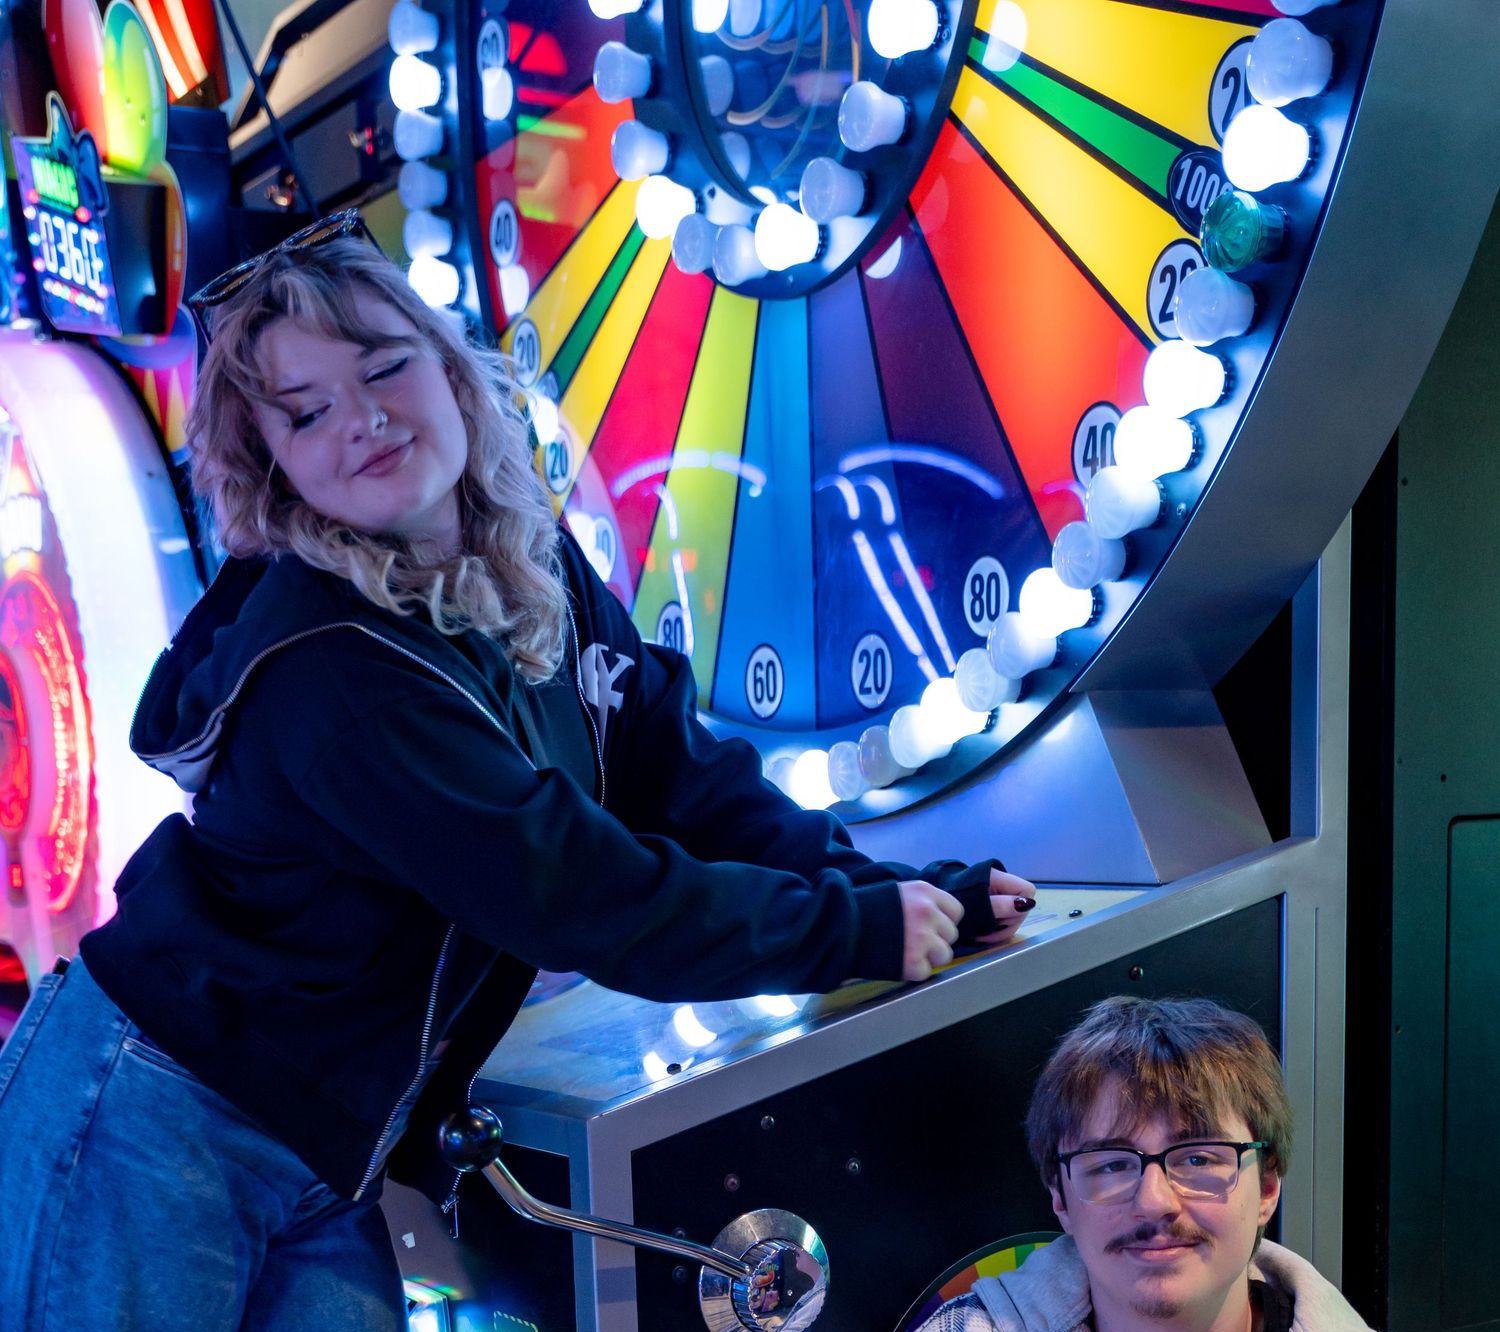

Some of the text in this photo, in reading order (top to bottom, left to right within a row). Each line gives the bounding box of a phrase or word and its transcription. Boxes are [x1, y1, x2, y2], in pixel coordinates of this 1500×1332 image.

[494, 213, 512, 251] 40
[516, 333, 536, 374] 20
[550, 441, 568, 479] 20
[1082, 422, 1117, 479] 40
[970, 572, 1001, 623] 80
[663, 617, 685, 654] 80
[753, 659, 778, 704] 60
[858, 648, 886, 695] 20
